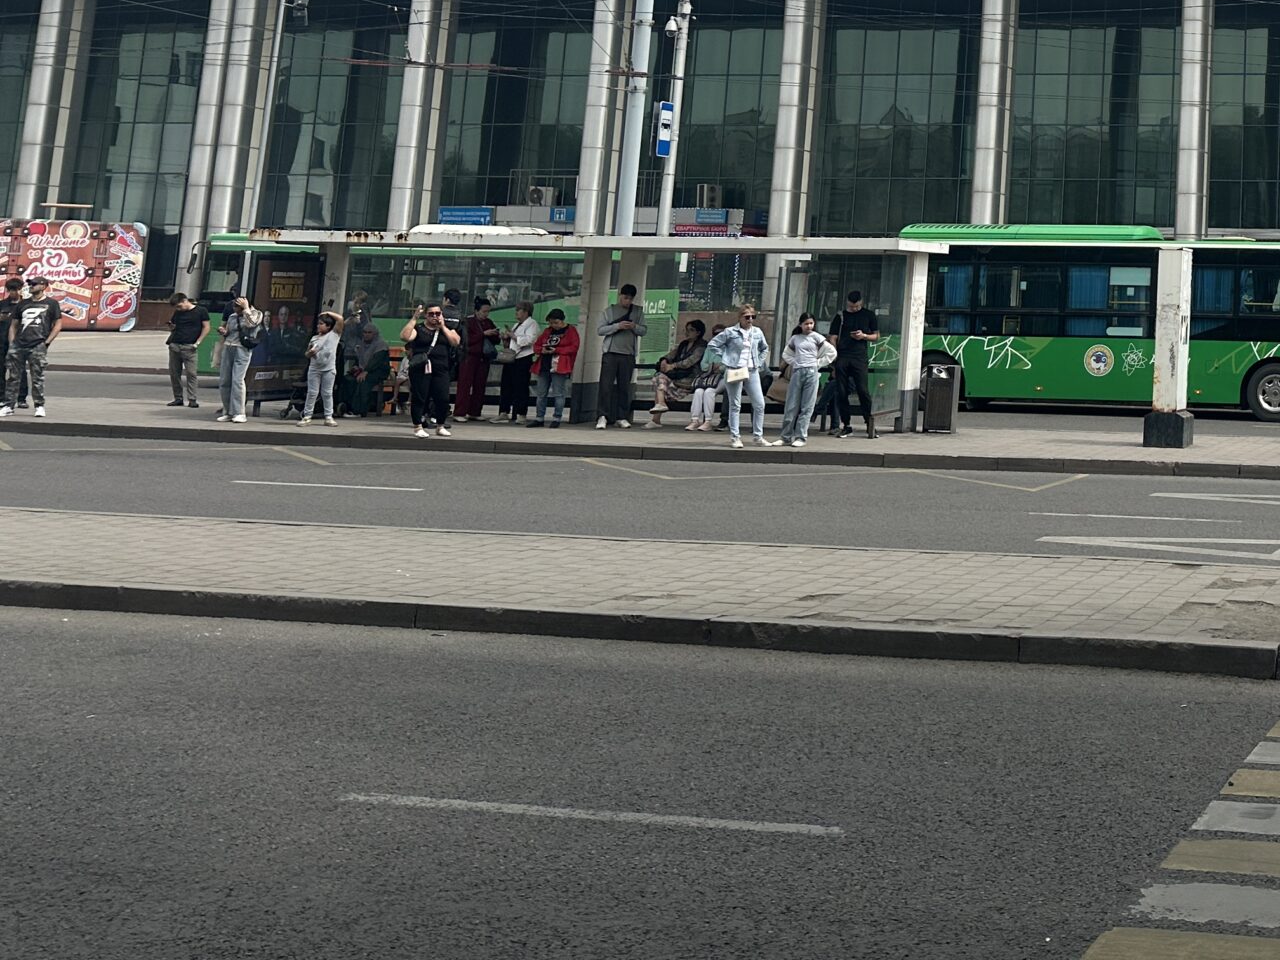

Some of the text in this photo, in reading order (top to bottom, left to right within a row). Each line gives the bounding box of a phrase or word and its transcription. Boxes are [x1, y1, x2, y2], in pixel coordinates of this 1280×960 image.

[28, 236, 88, 247] Welcome
[29, 250, 41, 259] to
[26, 264, 85, 279] Алматы
